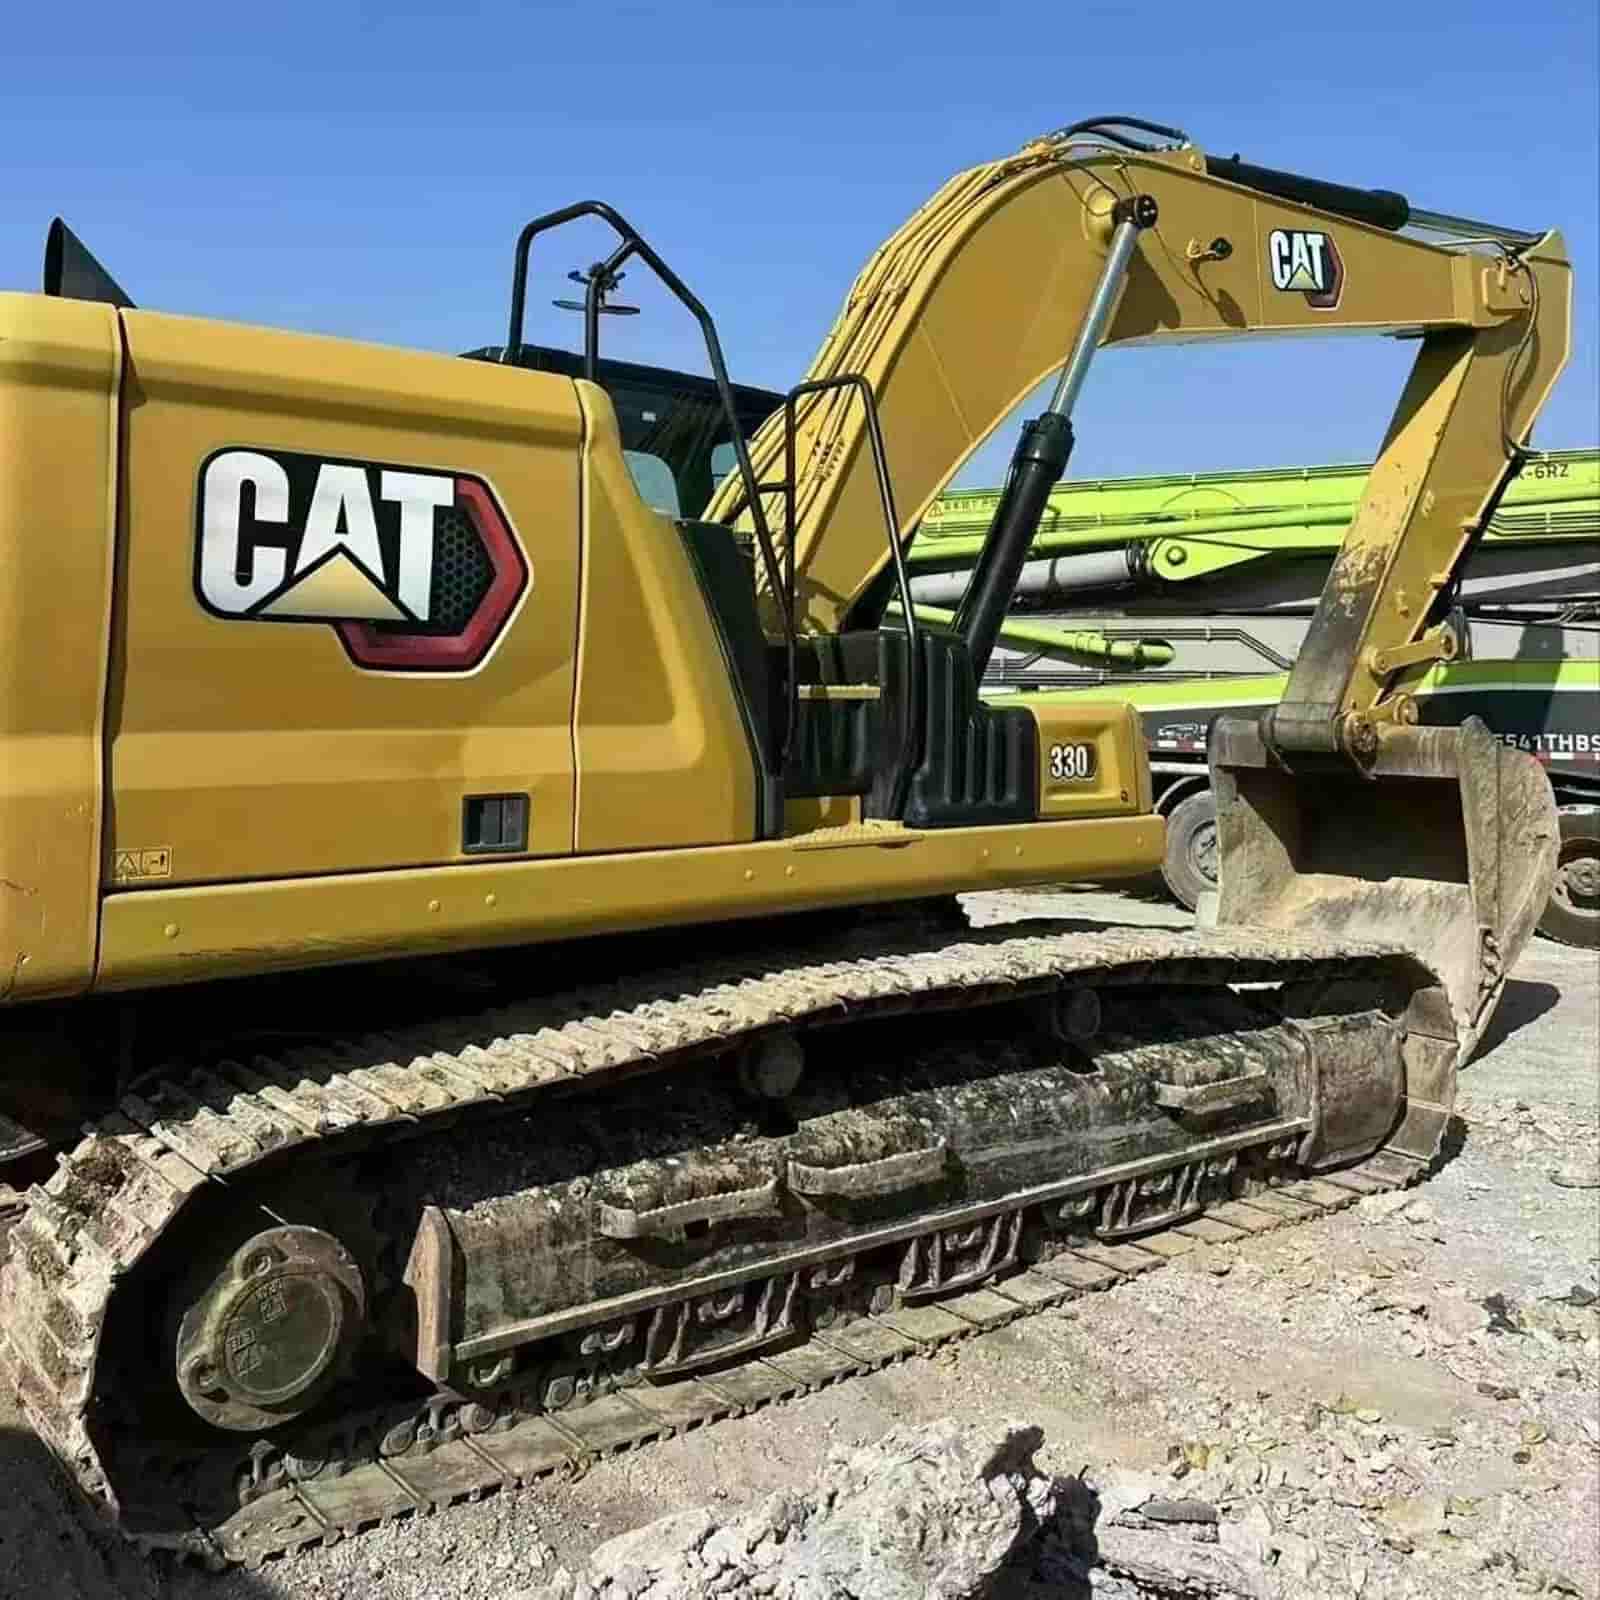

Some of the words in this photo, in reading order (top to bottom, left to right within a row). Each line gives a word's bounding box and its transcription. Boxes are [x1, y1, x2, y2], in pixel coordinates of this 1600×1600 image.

[1270, 230, 1324, 289] CAT
[201, 450, 455, 621] CAT
[1050, 745, 1088, 778] 330
